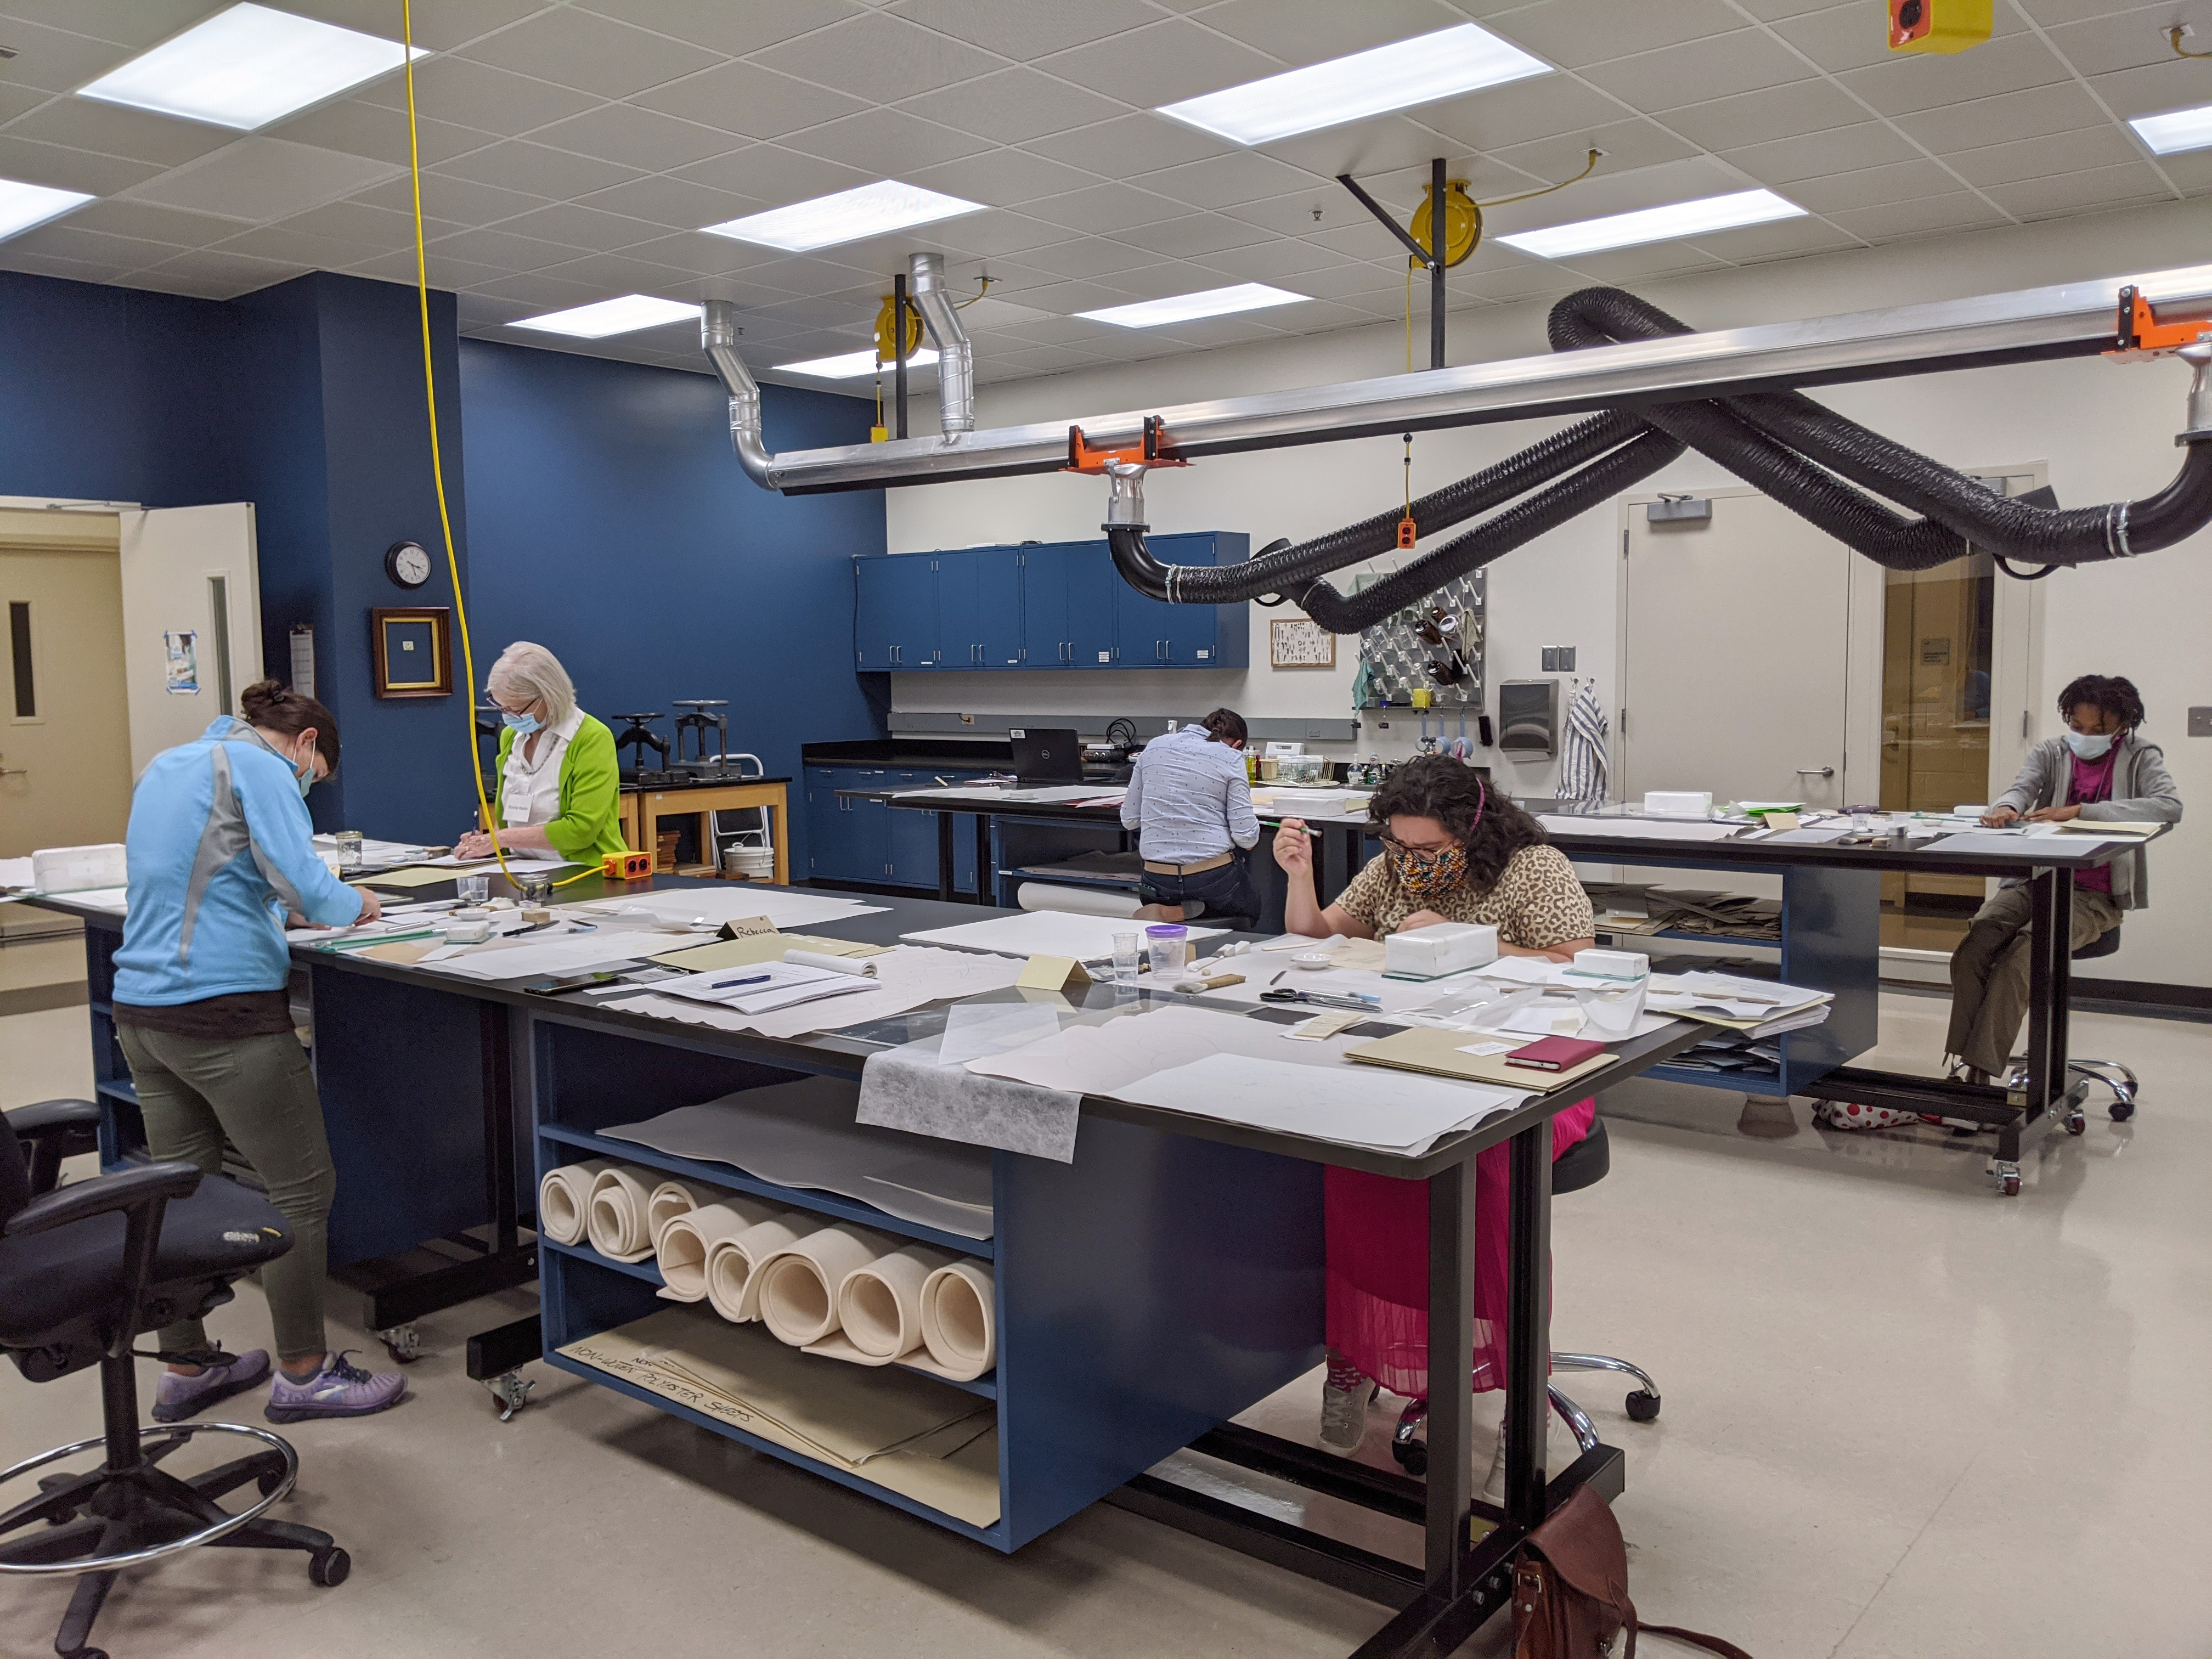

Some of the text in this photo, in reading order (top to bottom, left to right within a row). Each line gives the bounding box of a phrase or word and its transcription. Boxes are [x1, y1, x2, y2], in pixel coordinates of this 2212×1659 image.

[737, 927, 776, 938] Rebecca
[637, 1373, 704, 1403] POLYESTER
[704, 1401, 754, 1422] SHEETS
